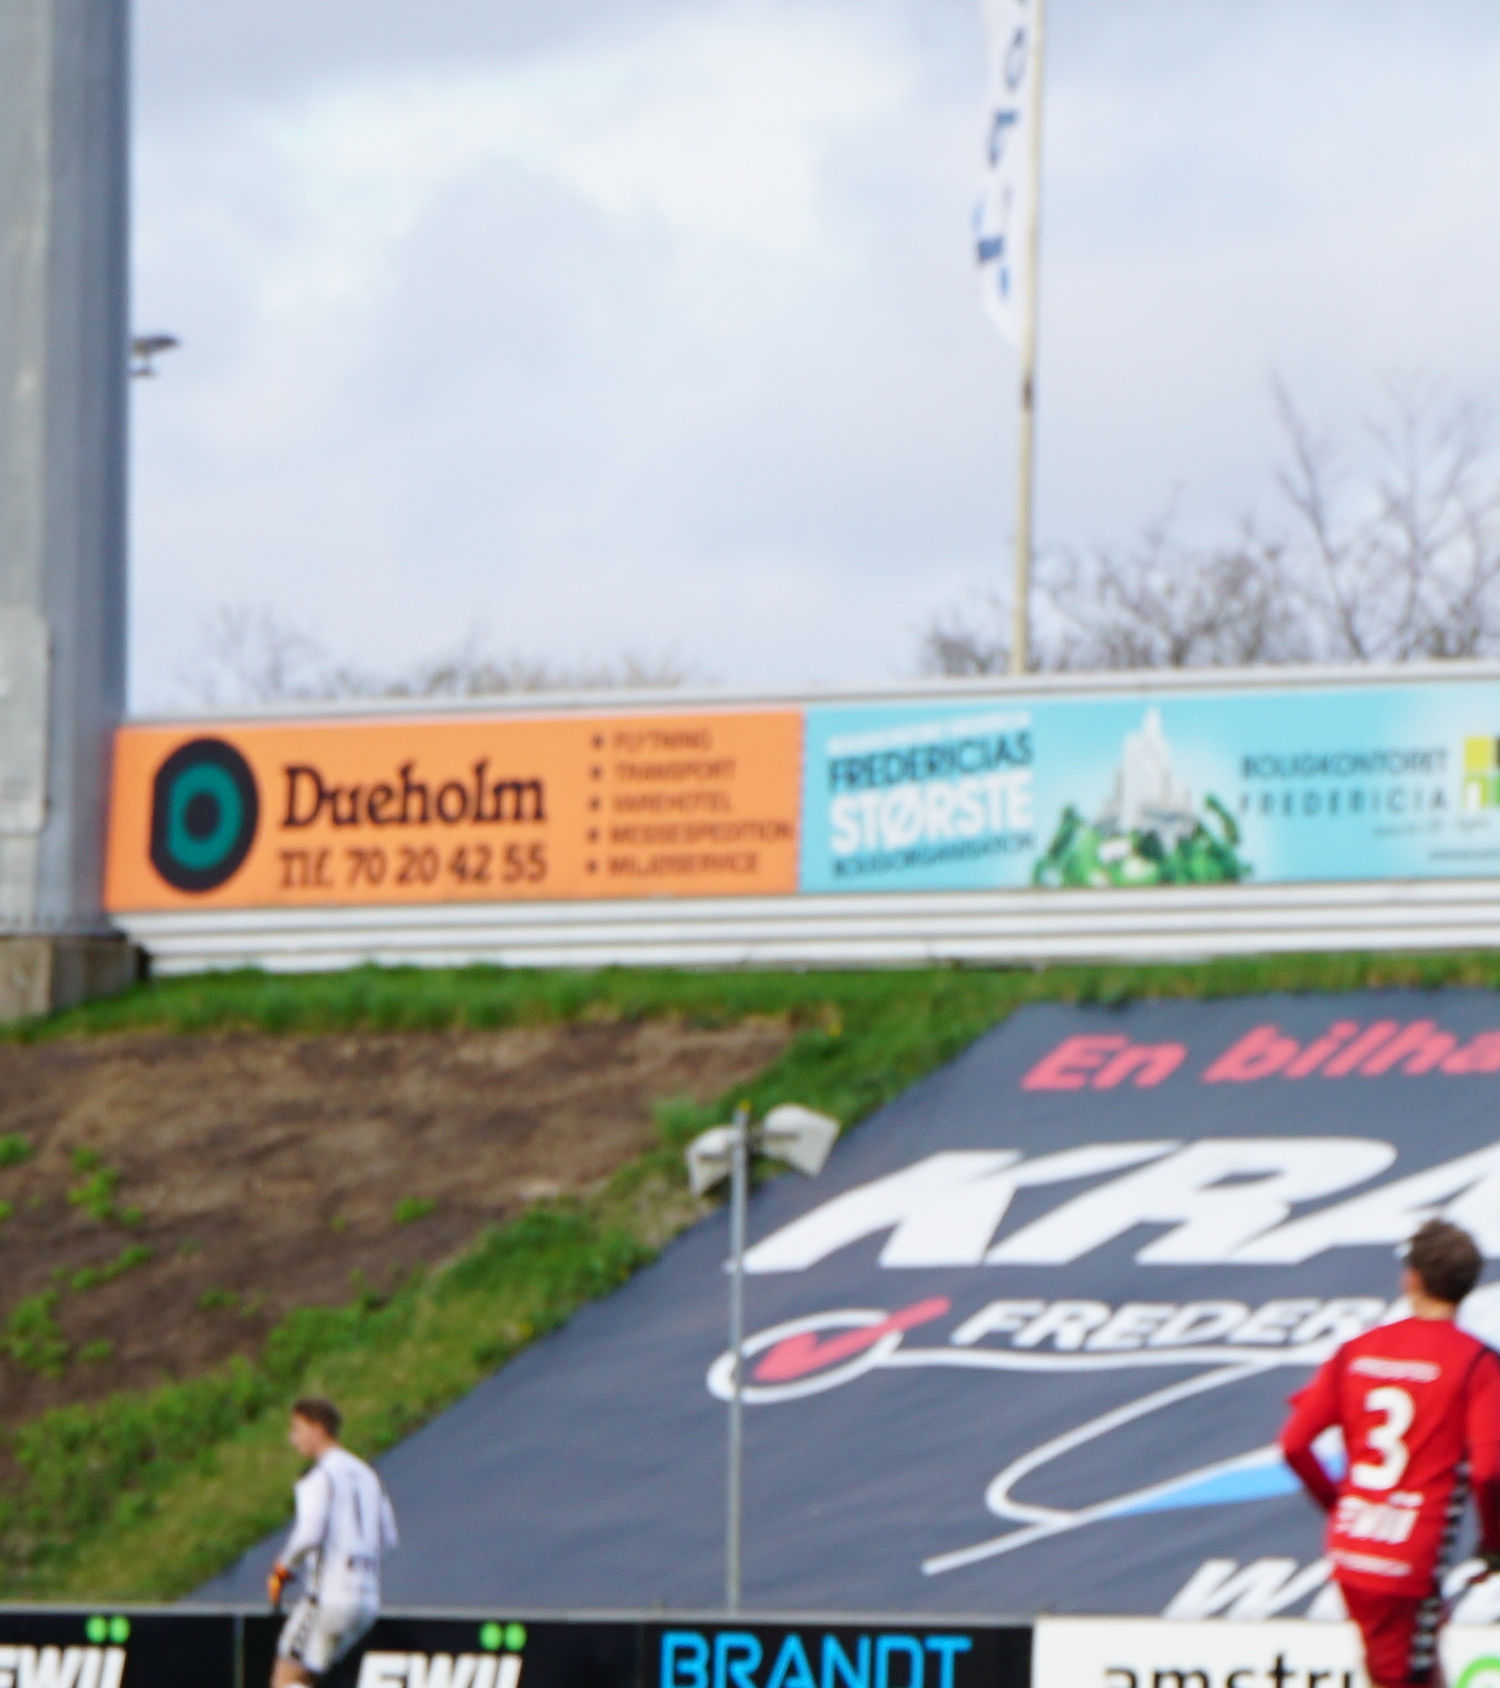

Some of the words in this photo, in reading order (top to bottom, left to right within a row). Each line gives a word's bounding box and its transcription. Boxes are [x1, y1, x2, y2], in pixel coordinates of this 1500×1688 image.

[280, 757, 547, 830] Dueholm
[828, 730, 1033, 791] FREDERICIAS
[830, 768, 1033, 857] STØRSTE
[348, 848, 388, 887] 70
[397, 847, 441, 886] 20
[450, 844, 493, 884] 42
[504, 842, 548, 882] 55
[1020, 1033, 1188, 1091] En
[1350, 1386, 1415, 1491] 3
